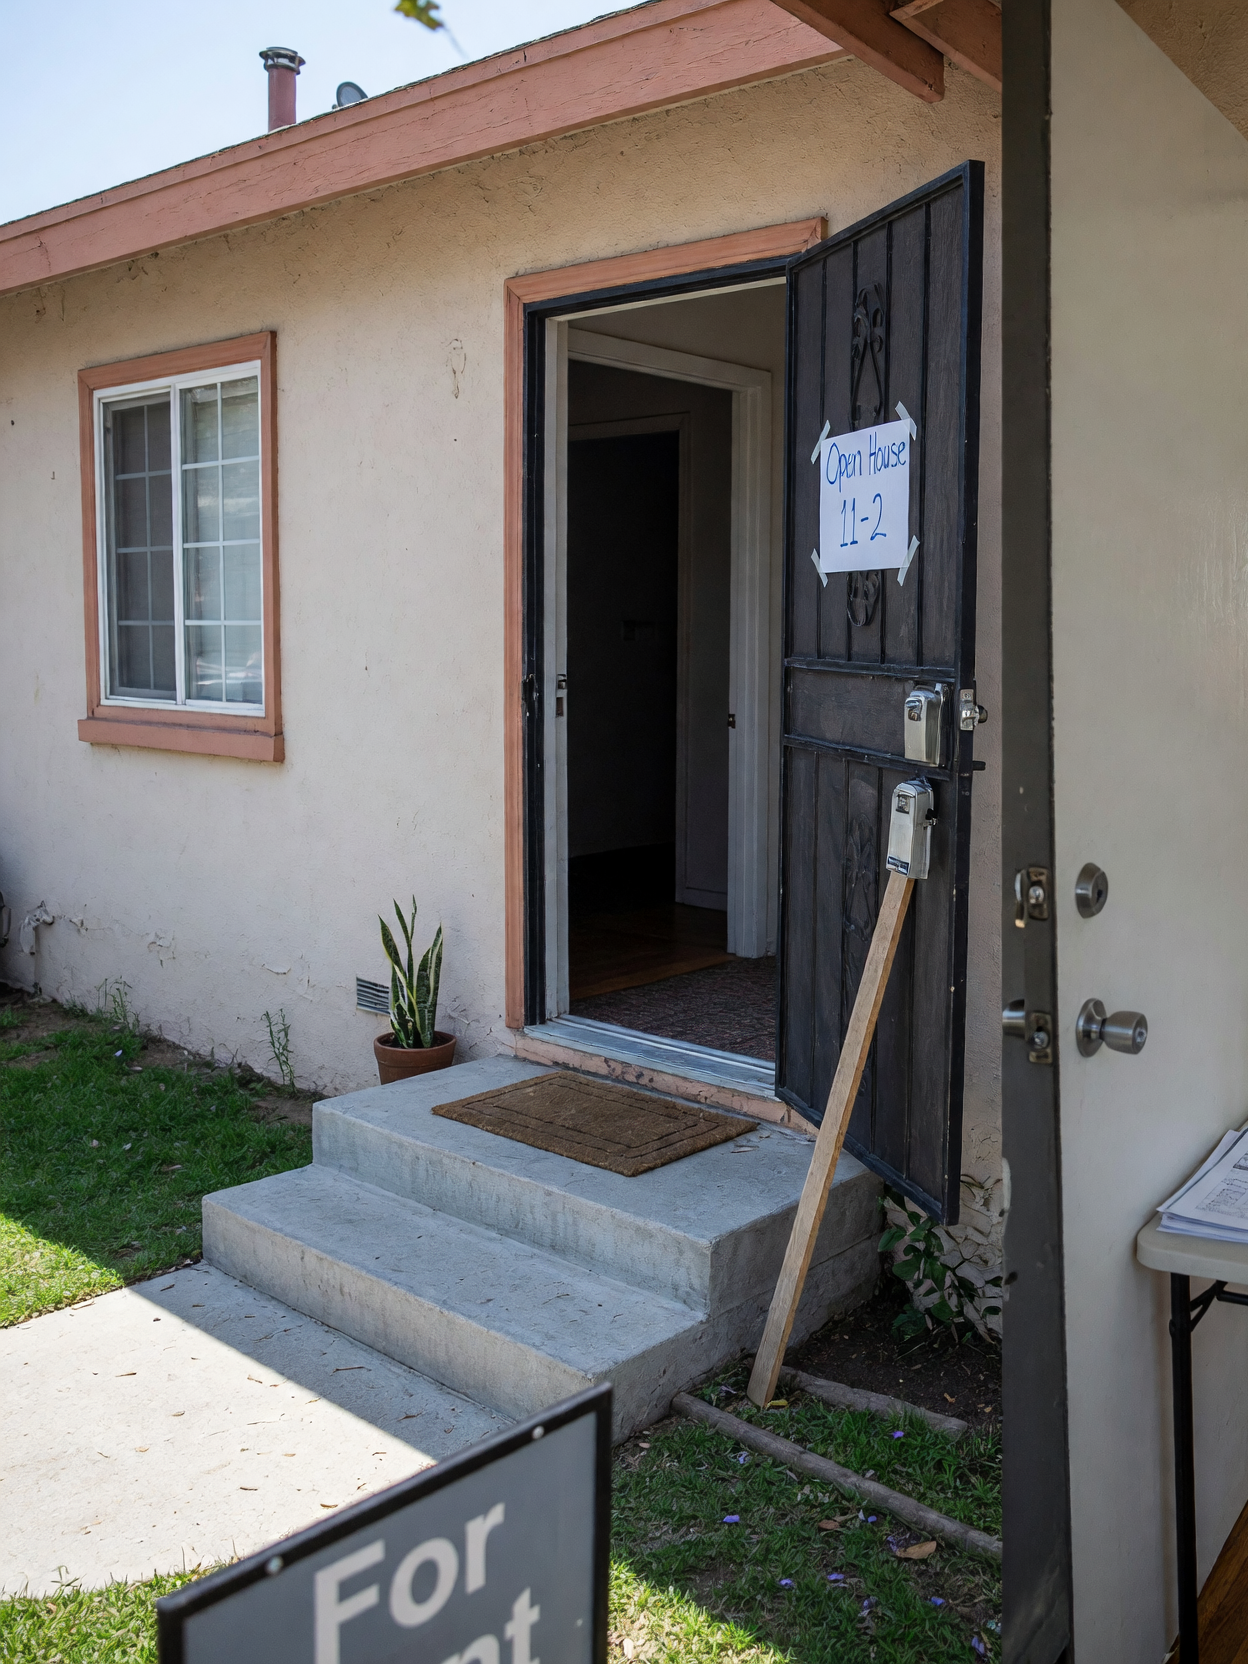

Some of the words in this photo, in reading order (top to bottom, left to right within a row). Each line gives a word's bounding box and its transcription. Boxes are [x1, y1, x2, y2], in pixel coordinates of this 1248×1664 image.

[826, 442, 862, 493] Open
[868, 431, 906, 475] House
[840, 493, 887, 547] 11-2
[314, 1502, 505, 1664] For
